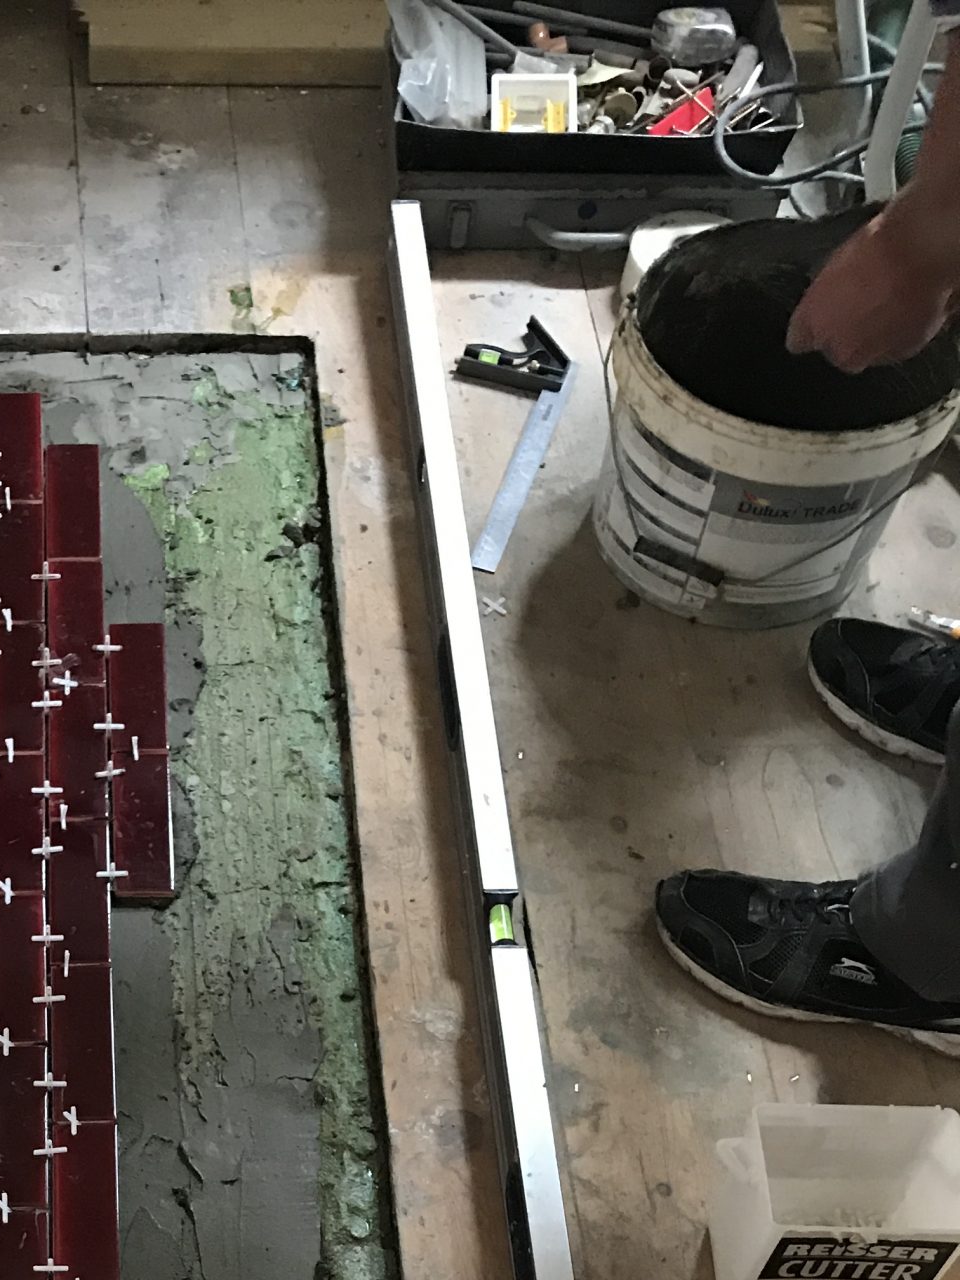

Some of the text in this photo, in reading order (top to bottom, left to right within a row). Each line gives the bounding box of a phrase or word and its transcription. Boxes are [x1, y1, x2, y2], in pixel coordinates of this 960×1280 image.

[737, 499, 862, 519] Dulux TRADE
[782, 1243, 939, 1261] REISSER
